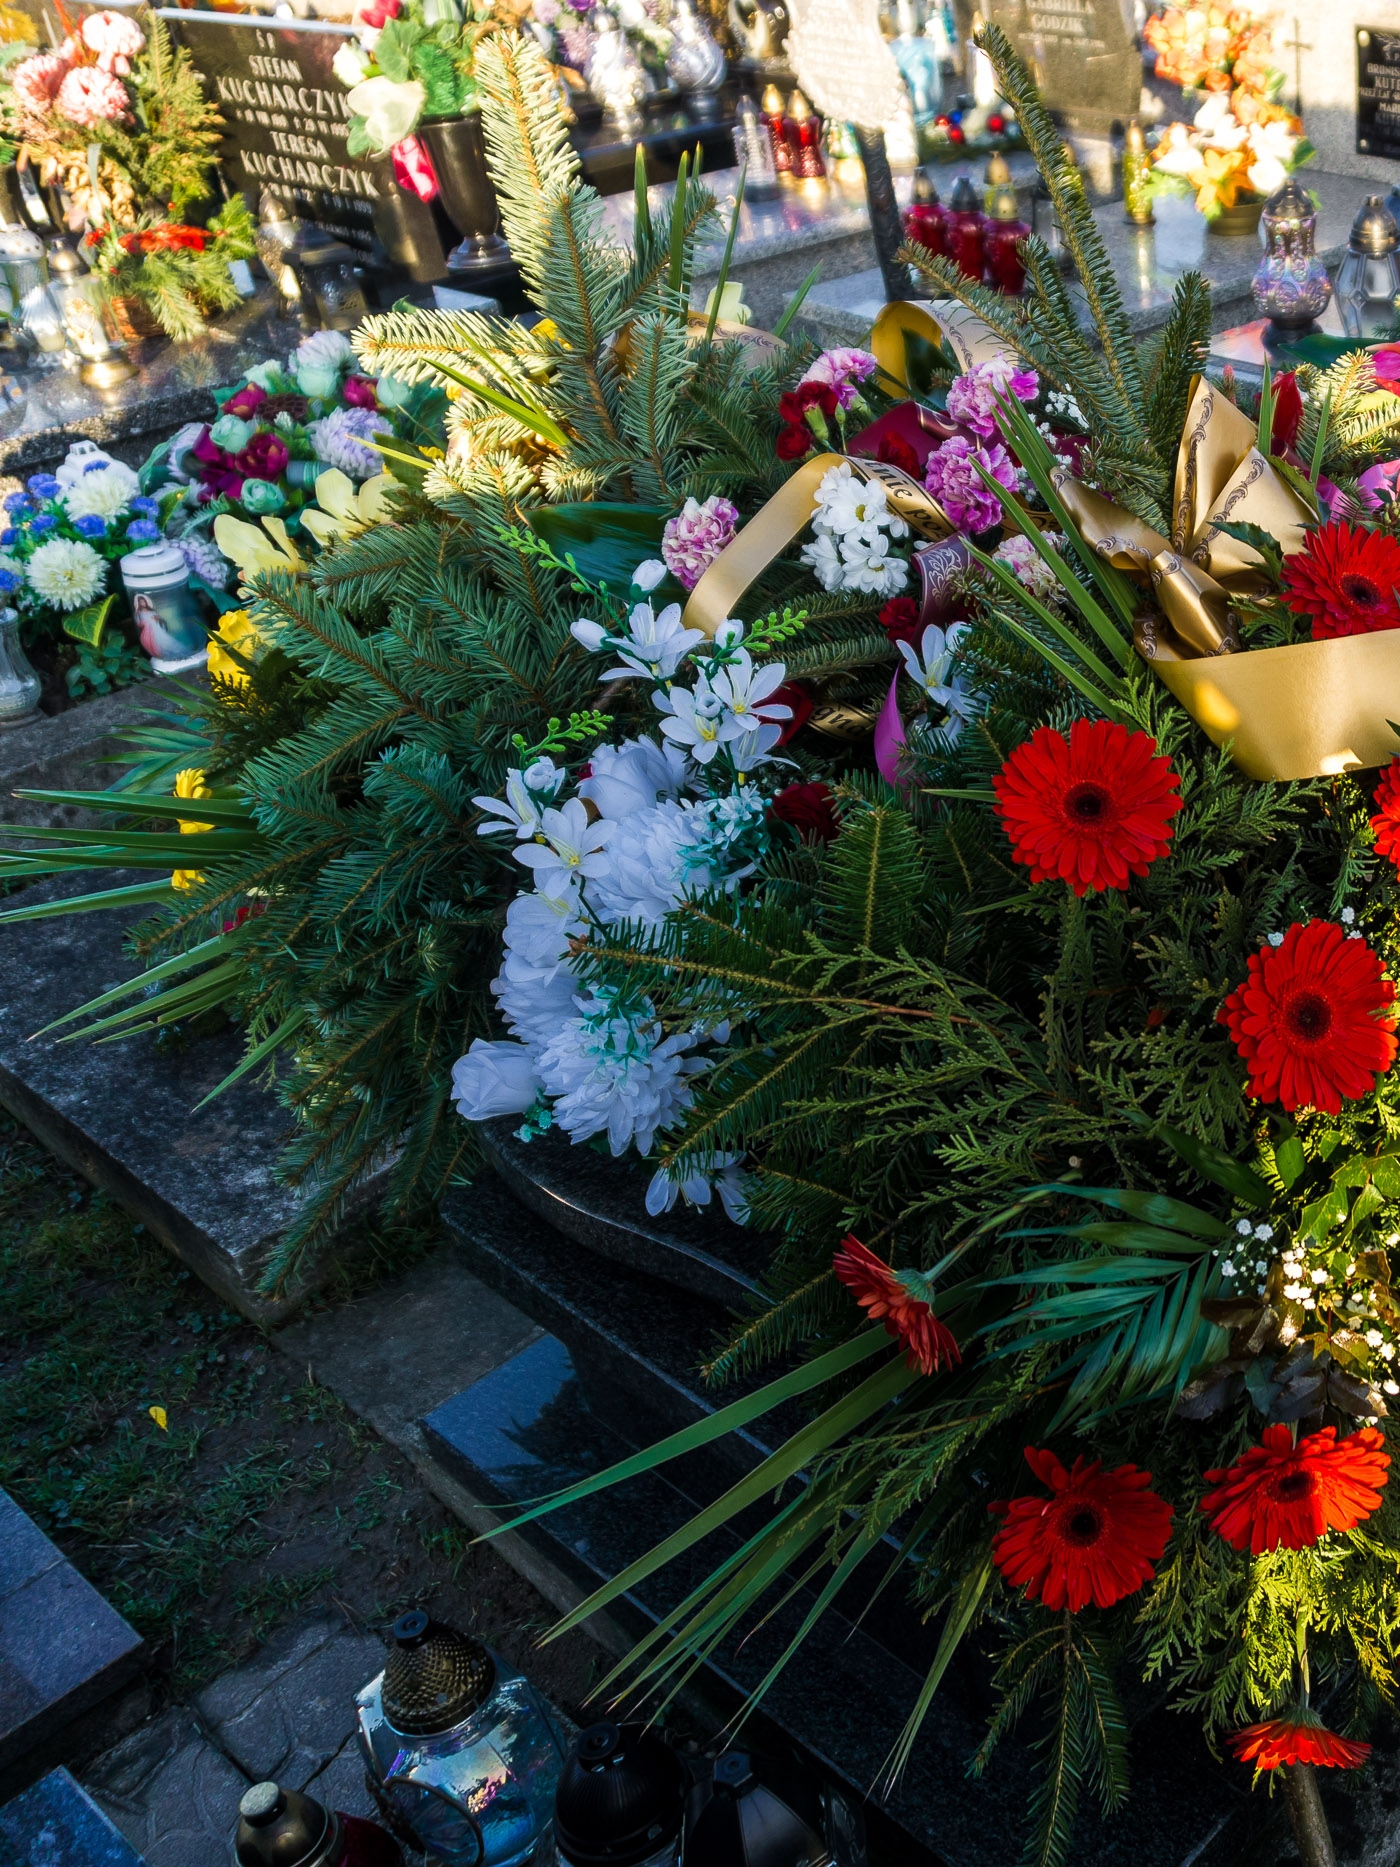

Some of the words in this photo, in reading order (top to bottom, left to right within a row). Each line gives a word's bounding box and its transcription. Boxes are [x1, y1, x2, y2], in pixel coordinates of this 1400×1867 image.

[249, 54, 303, 82] STEFAN
[216, 75, 354, 119] KUCHARCZYK
[270, 130, 330, 159] TERESA
[240, 149, 380, 200] KUCHARCZYK
